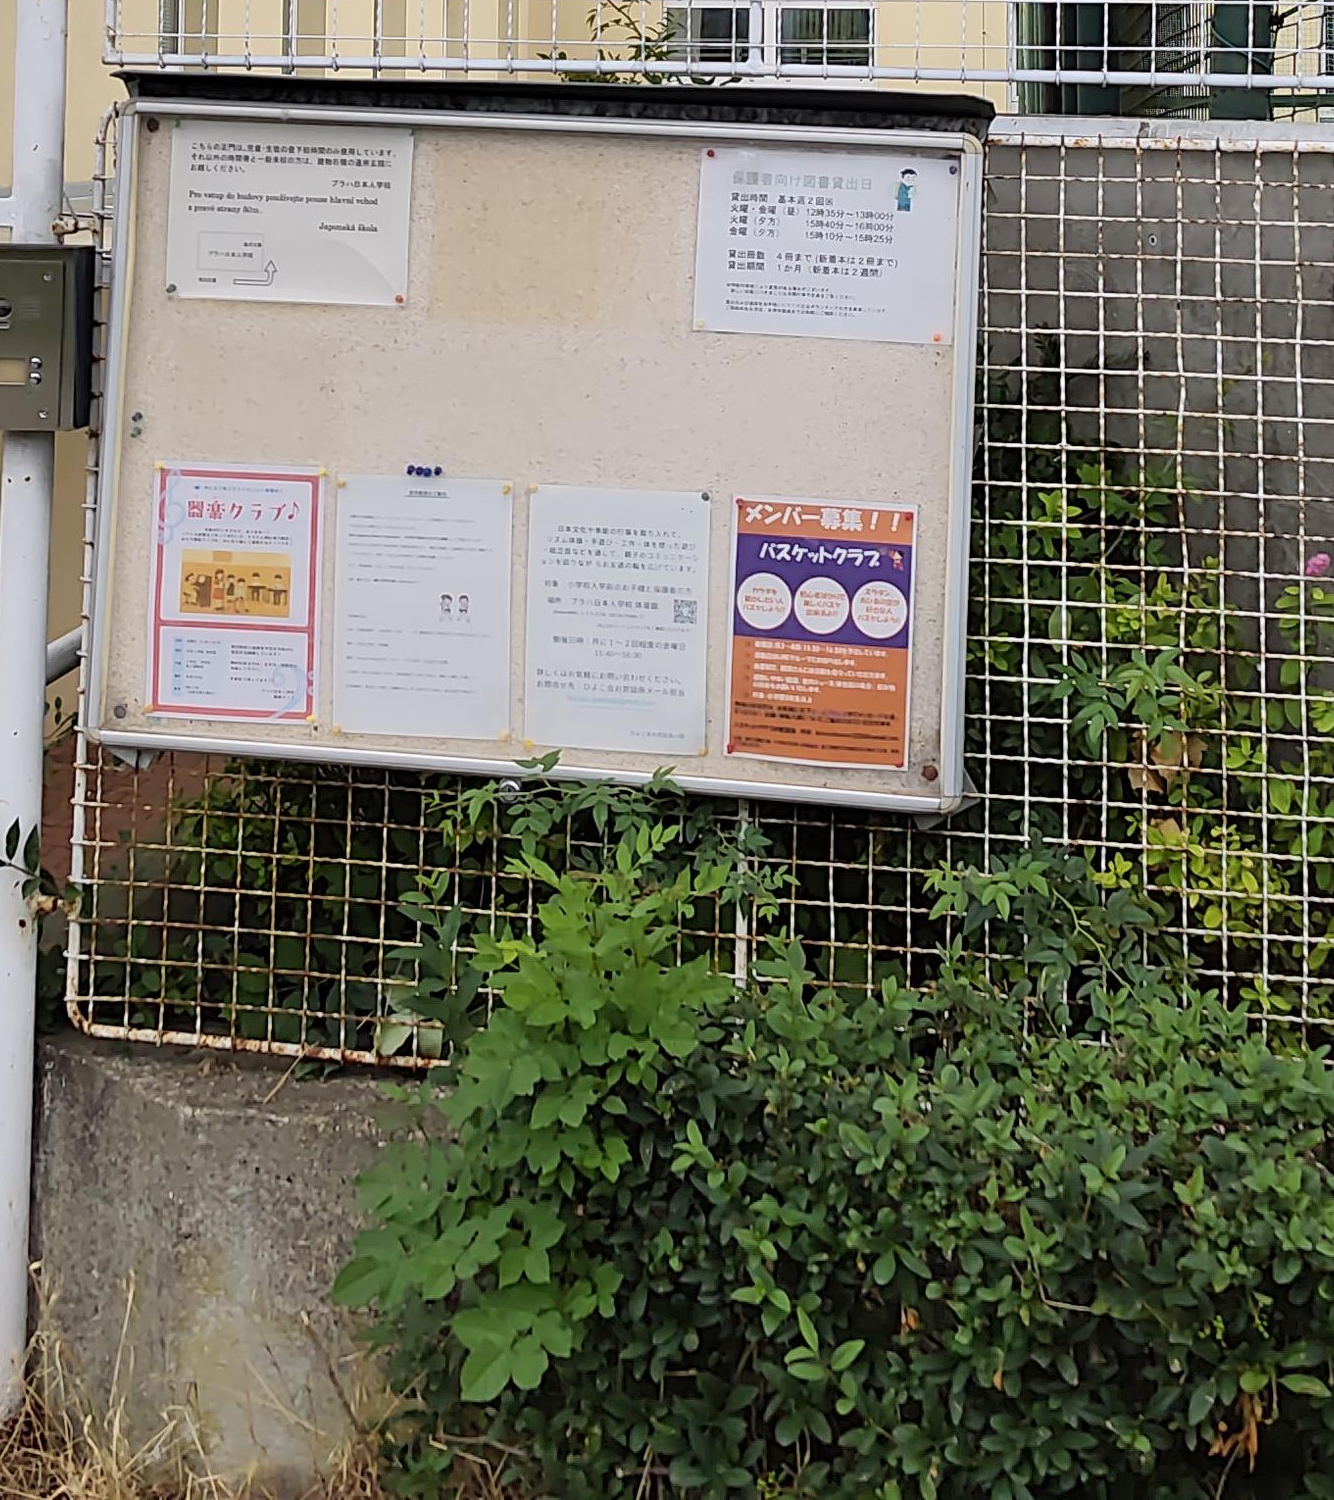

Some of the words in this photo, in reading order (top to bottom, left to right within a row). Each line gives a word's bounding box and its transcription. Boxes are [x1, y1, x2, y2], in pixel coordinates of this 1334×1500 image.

[331, 180, 392, 190] プラハ日本人学校
[733, 171, 873, 191] 保護者向け図書貸出日
[188, 190, 203, 199] Pro
[204, 192, 224, 201] vstup
[226, 192, 235, 200] do
[237, 192, 264, 202] budovy
[306, 196, 327, 205] pouze
[329, 195, 354, 205] hlavní
[356, 197, 378, 206] vchod
[731, 192, 769, 203] 貸出時間
[217, 206, 241, 215] strany
[319, 222, 355, 233] Japonská
[358, 222, 378, 233] škola
[728, 249, 765, 260] 貸出冊数
[727, 260, 765, 271] 貸出期間
[745, 503, 901, 533] メンバー募集！！
[759, 542, 881, 568] バスケットクラブ
